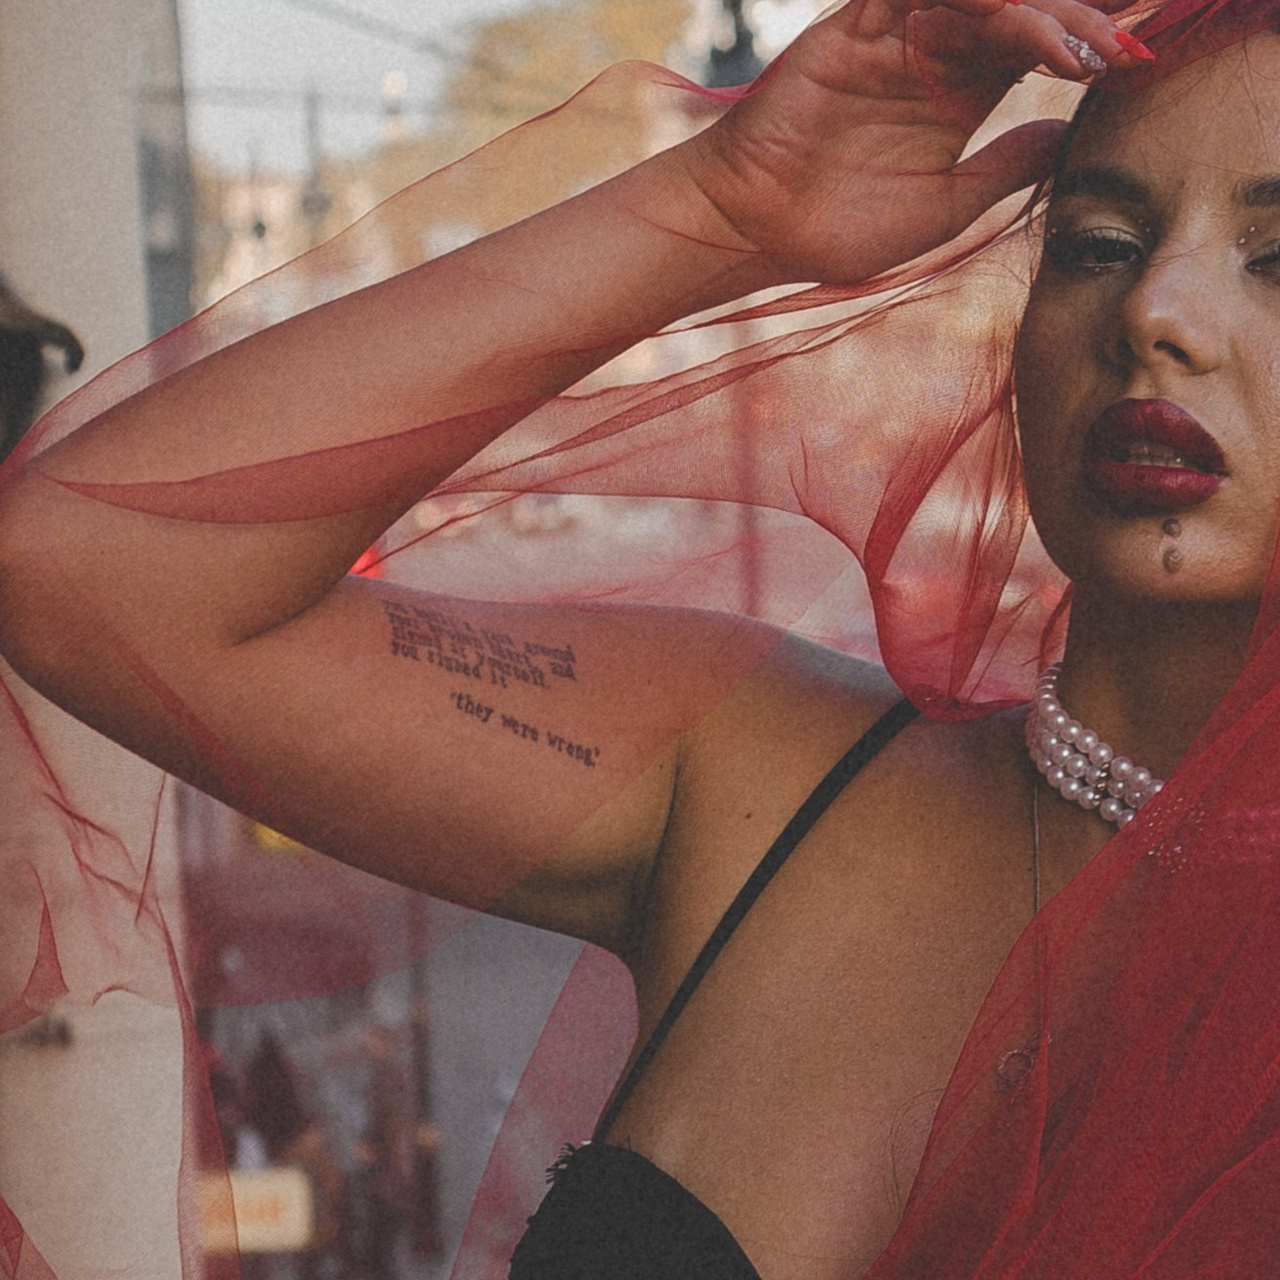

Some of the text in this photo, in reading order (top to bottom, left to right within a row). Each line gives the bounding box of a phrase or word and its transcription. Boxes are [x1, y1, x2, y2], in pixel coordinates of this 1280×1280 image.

[391, 640, 420, 661] you
[490, 667, 508, 689] it
[501, 714, 539, 742] were
